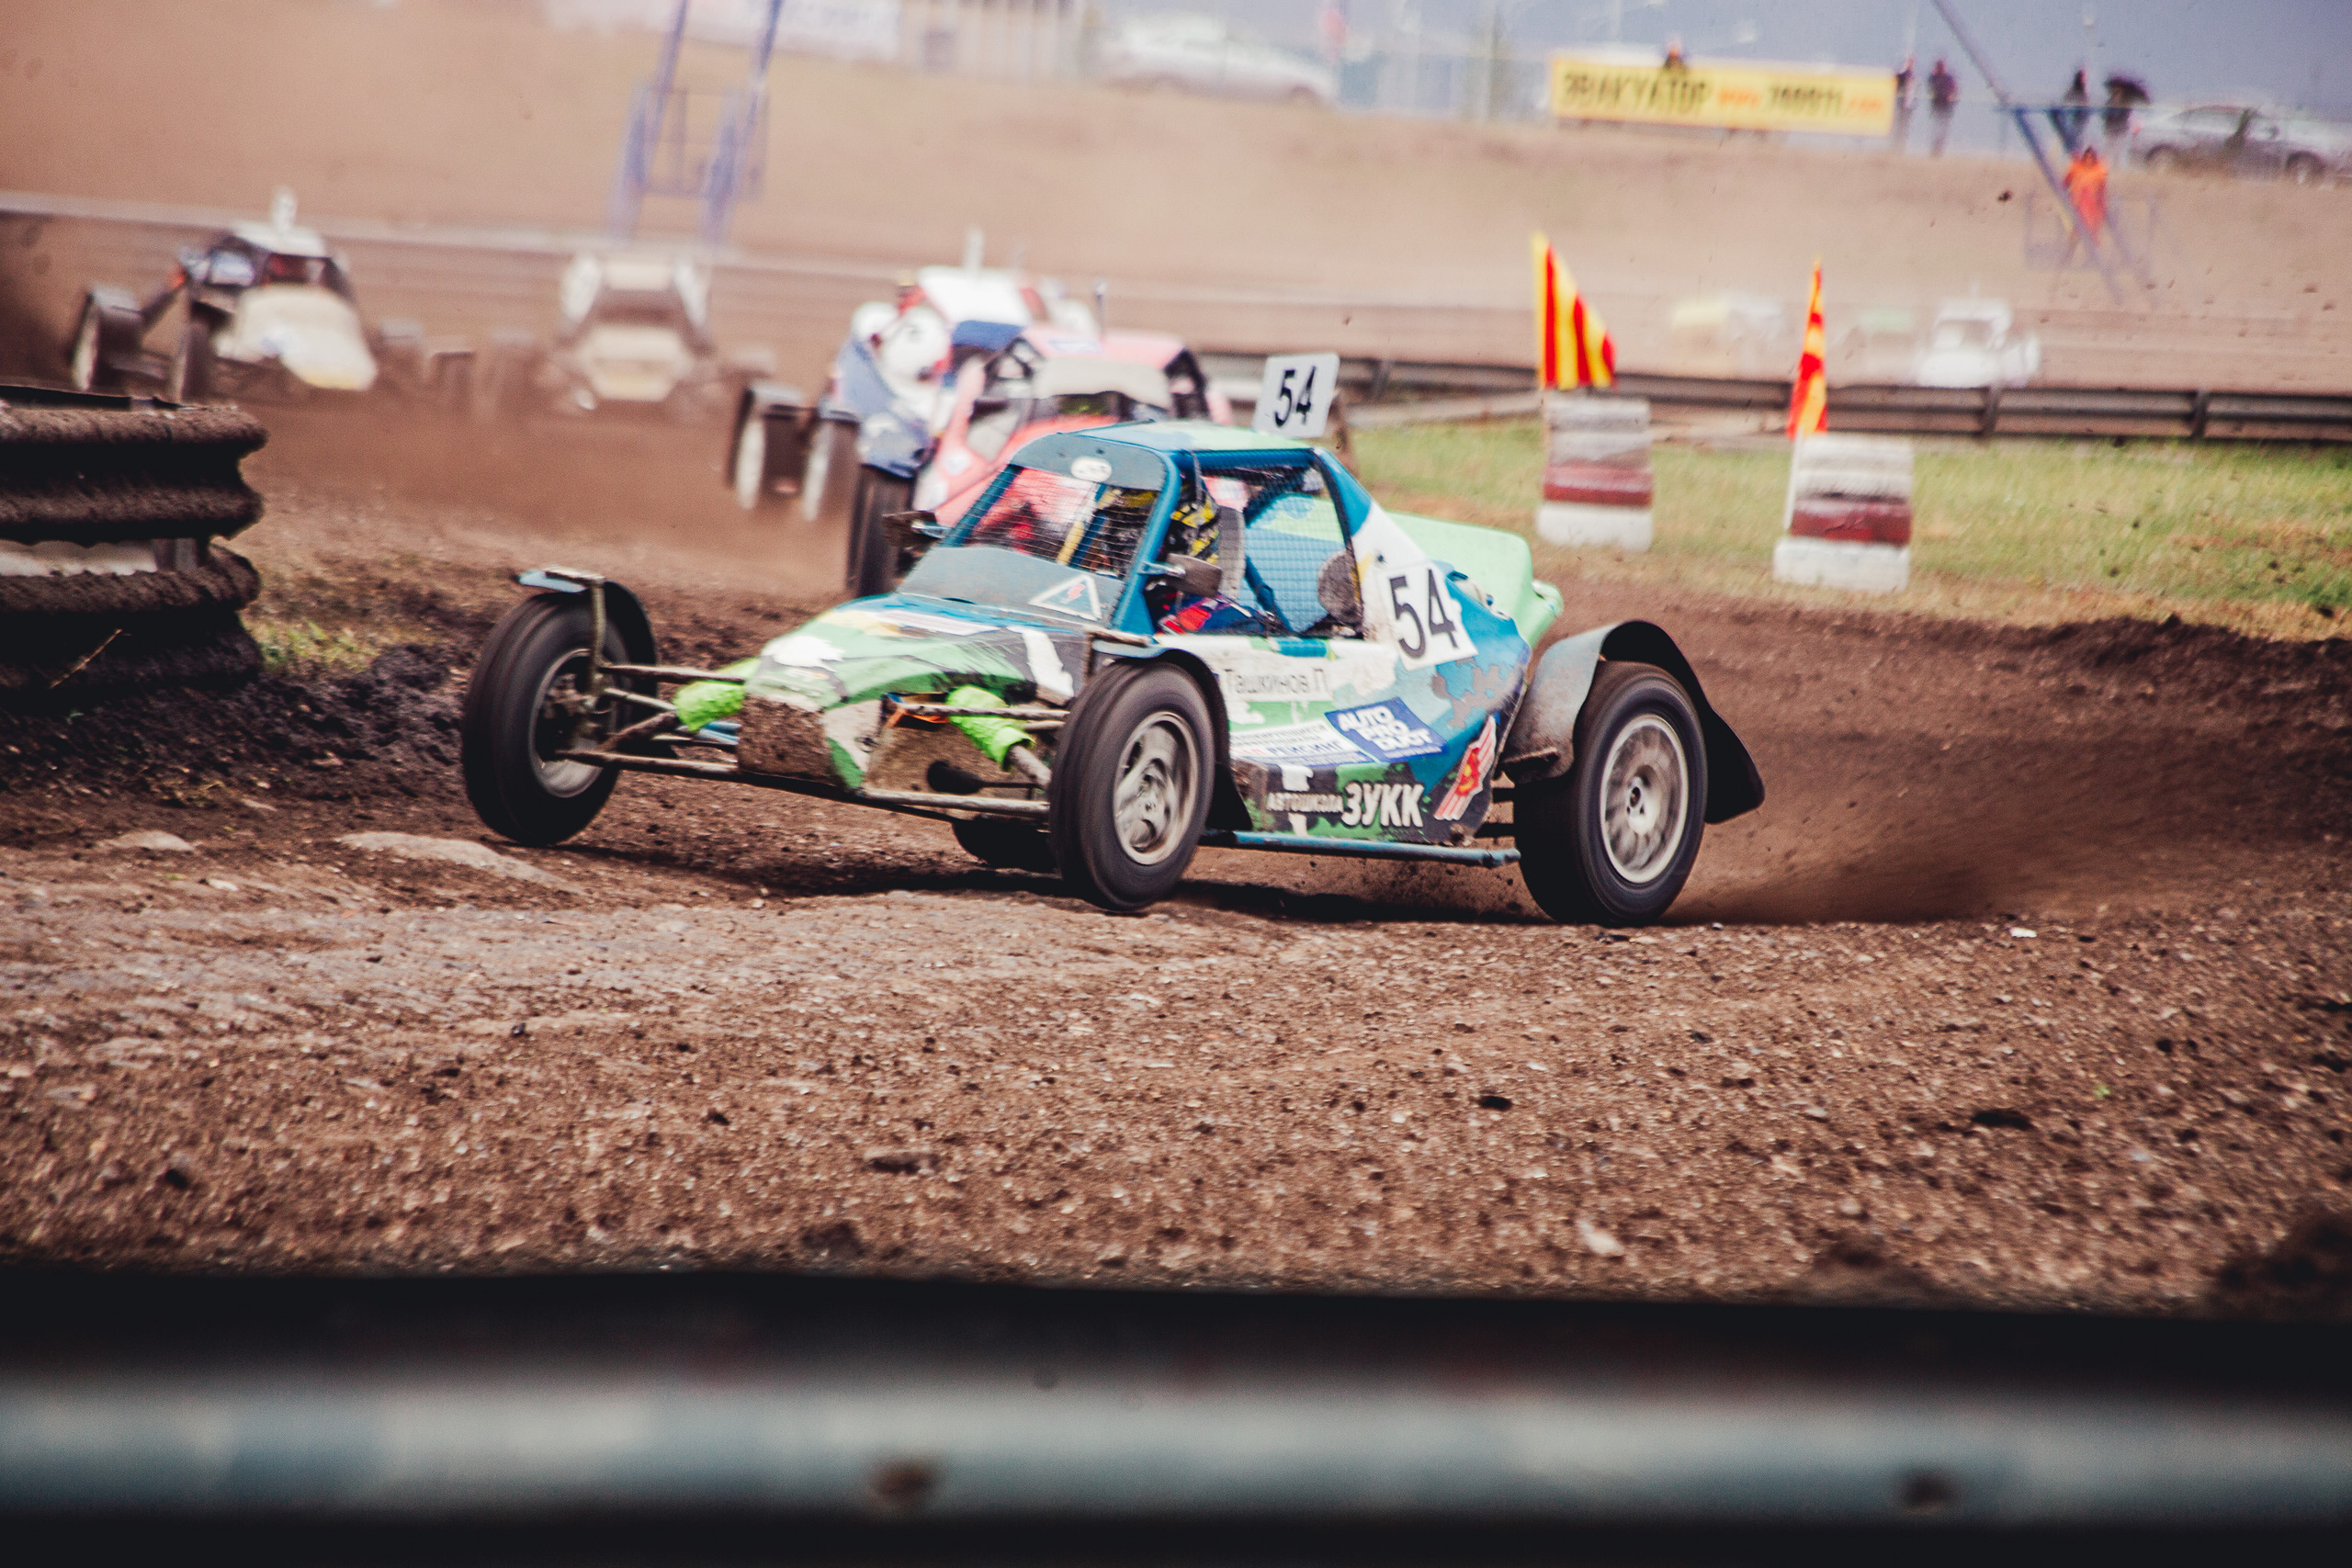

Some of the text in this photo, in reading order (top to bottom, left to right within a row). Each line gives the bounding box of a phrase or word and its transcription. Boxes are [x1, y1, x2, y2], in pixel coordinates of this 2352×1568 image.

[1274, 366, 1317, 428] 54
[1389, 569, 1459, 659] 54
[1224, 669, 1309, 694] Ташкинов
[1340, 706, 1395, 731] AUTO
[1356, 720, 1410, 741] PRO
[1373, 728, 1433, 751] DUCT
[1341, 783, 1424, 828] ЗУКК
